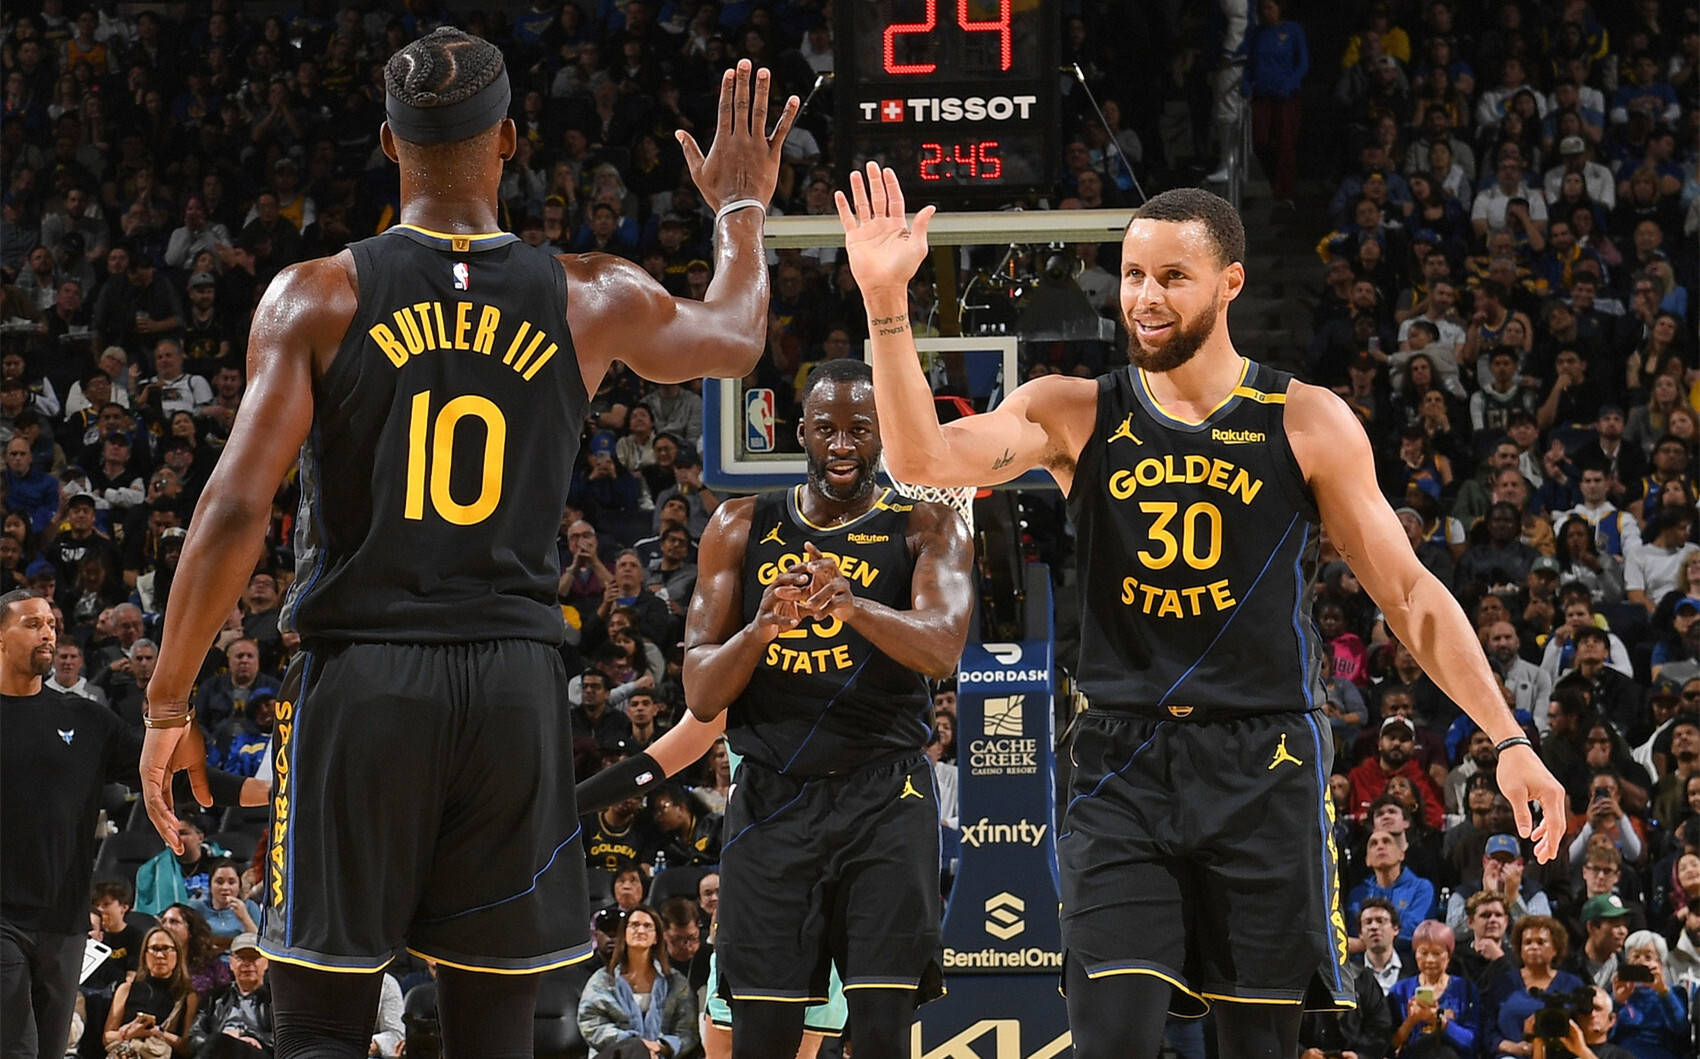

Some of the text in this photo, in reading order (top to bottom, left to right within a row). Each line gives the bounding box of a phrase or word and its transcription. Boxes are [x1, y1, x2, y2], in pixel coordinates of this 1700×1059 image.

[883, 0, 1012, 74] 24
[907, 96, 1037, 122] TISSOT
[920, 142, 1001, 180] 2:45
[368, 301, 559, 382] BUTLER III
[1211, 428, 1266, 445] Rakuten
[404, 389, 507, 526] 10
[1108, 454, 1264, 506] GOLDEN
[847, 532, 889, 545] Rakuten
[1136, 501, 1223, 571] 30
[1121, 576, 1237, 619] STATE
[766, 643, 854, 675] STATE
[960, 669, 1049, 683] DOORDASH
[969, 739, 1037, 754] CACHE
[969, 753, 1037, 768] CREEK
[971, 766, 1038, 776] CASINO RESORT
[960, 817, 1048, 849] xfinity
[590, 843, 637, 860] GOLDEN
